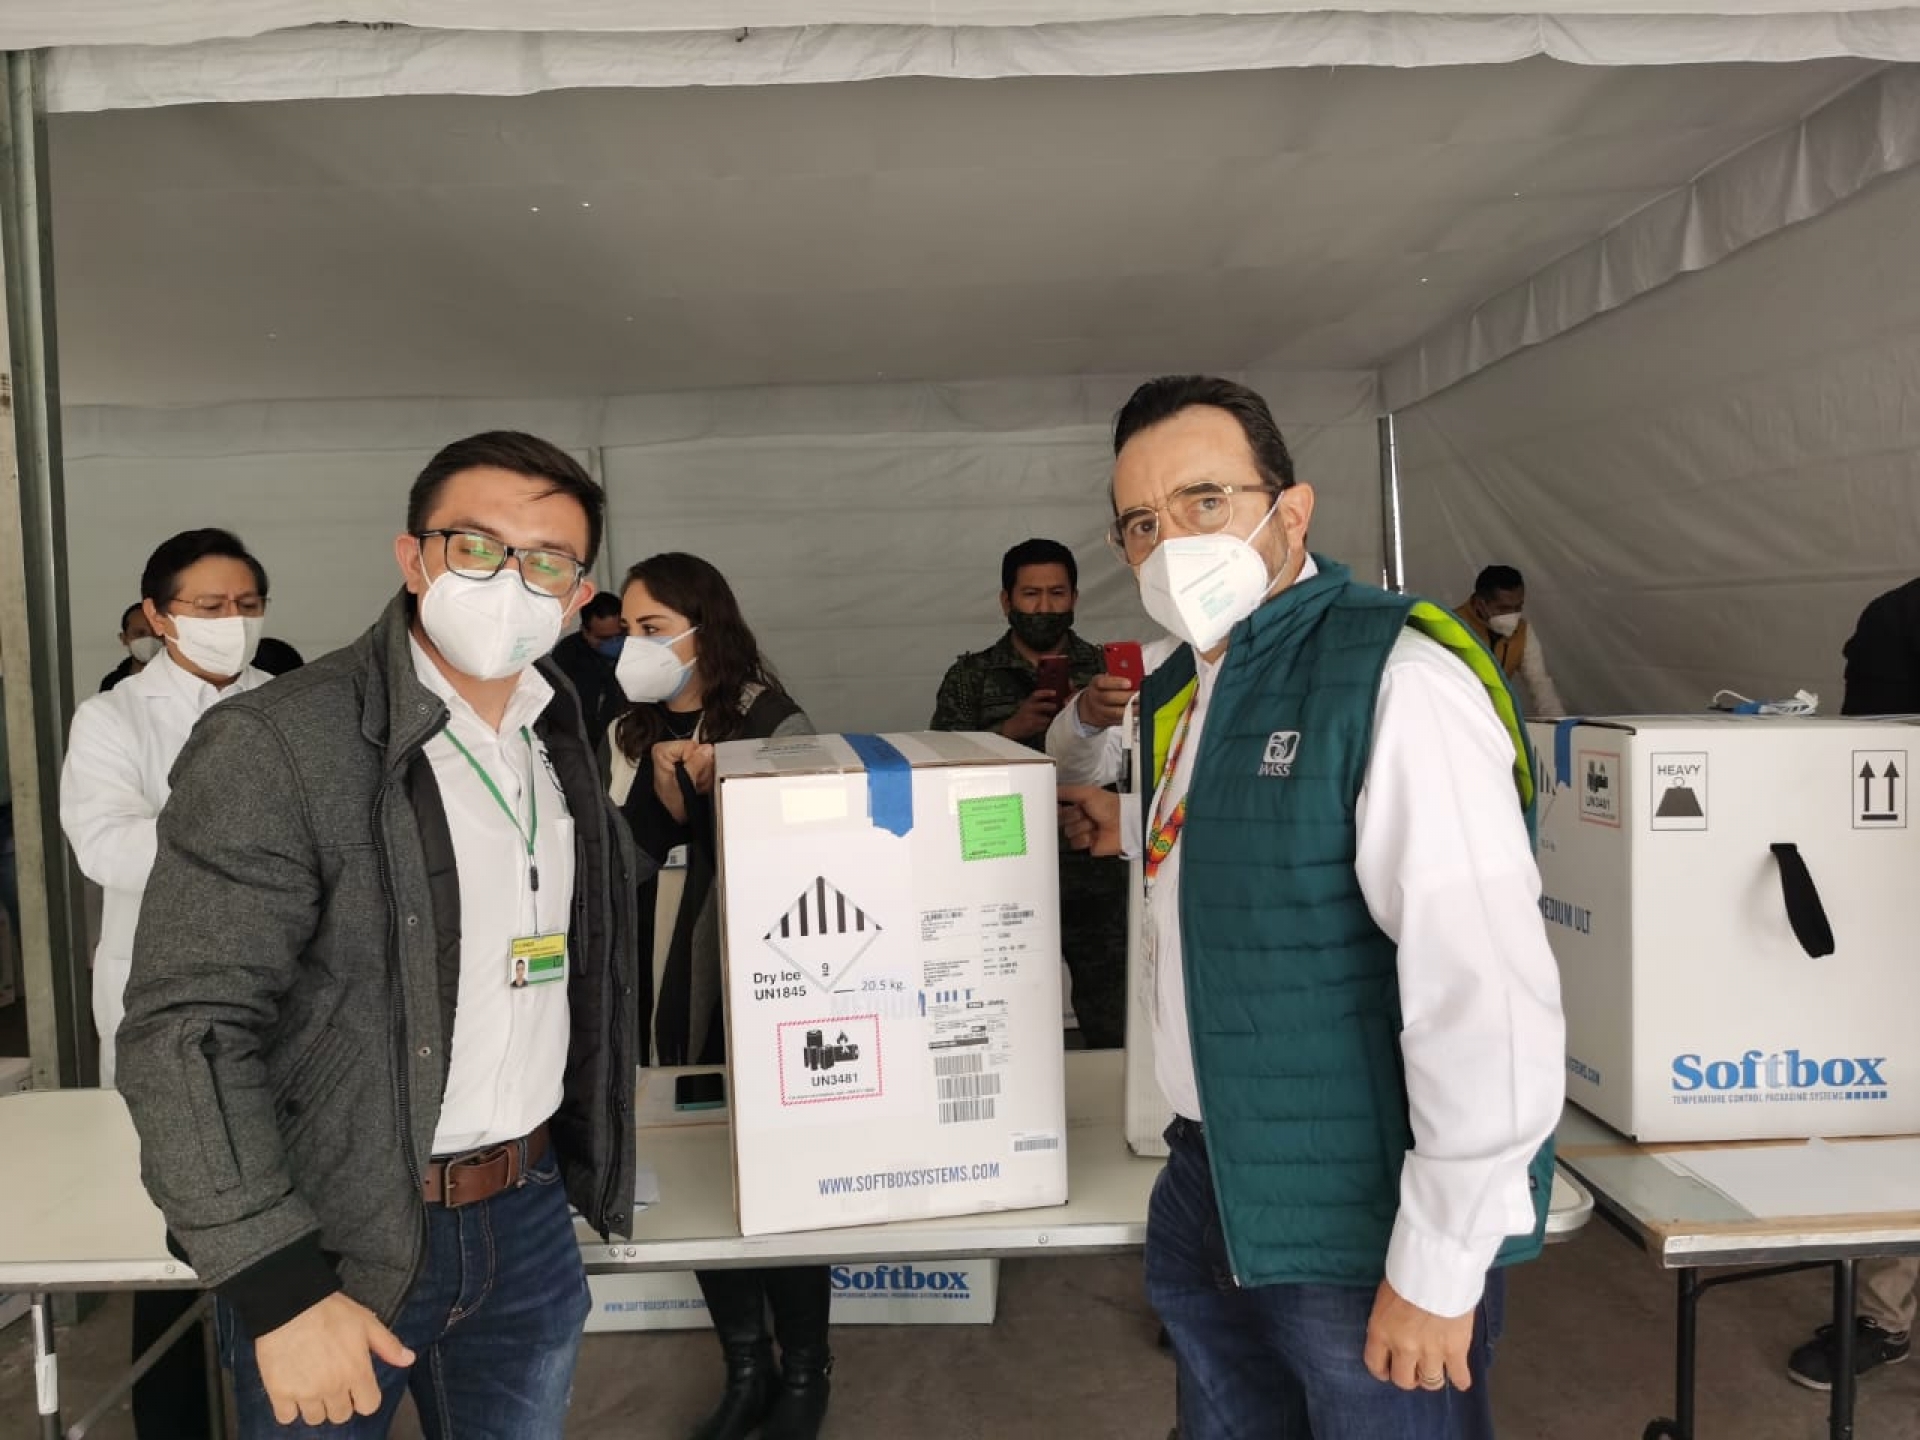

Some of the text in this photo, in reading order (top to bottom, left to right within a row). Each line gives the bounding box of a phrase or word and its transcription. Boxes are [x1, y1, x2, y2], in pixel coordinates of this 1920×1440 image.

[1657, 765, 1701, 776] HEAVY
[753, 971, 777, 985] Dry
[754, 985, 807, 1001] UN1845
[861, 980, 886, 992] 20.5
[1671, 1049, 1887, 1091] Softbox
[811, 1073, 858, 1088] UN3481
[1673, 1094, 1726, 1105] TEMPERATURE
[1728, 1092, 1762, 1104] CONTROL
[818, 1162, 1000, 1195] WWW.SOFTBOXSYSTEMS.COM
[831, 1265, 970, 1291] Softbox
